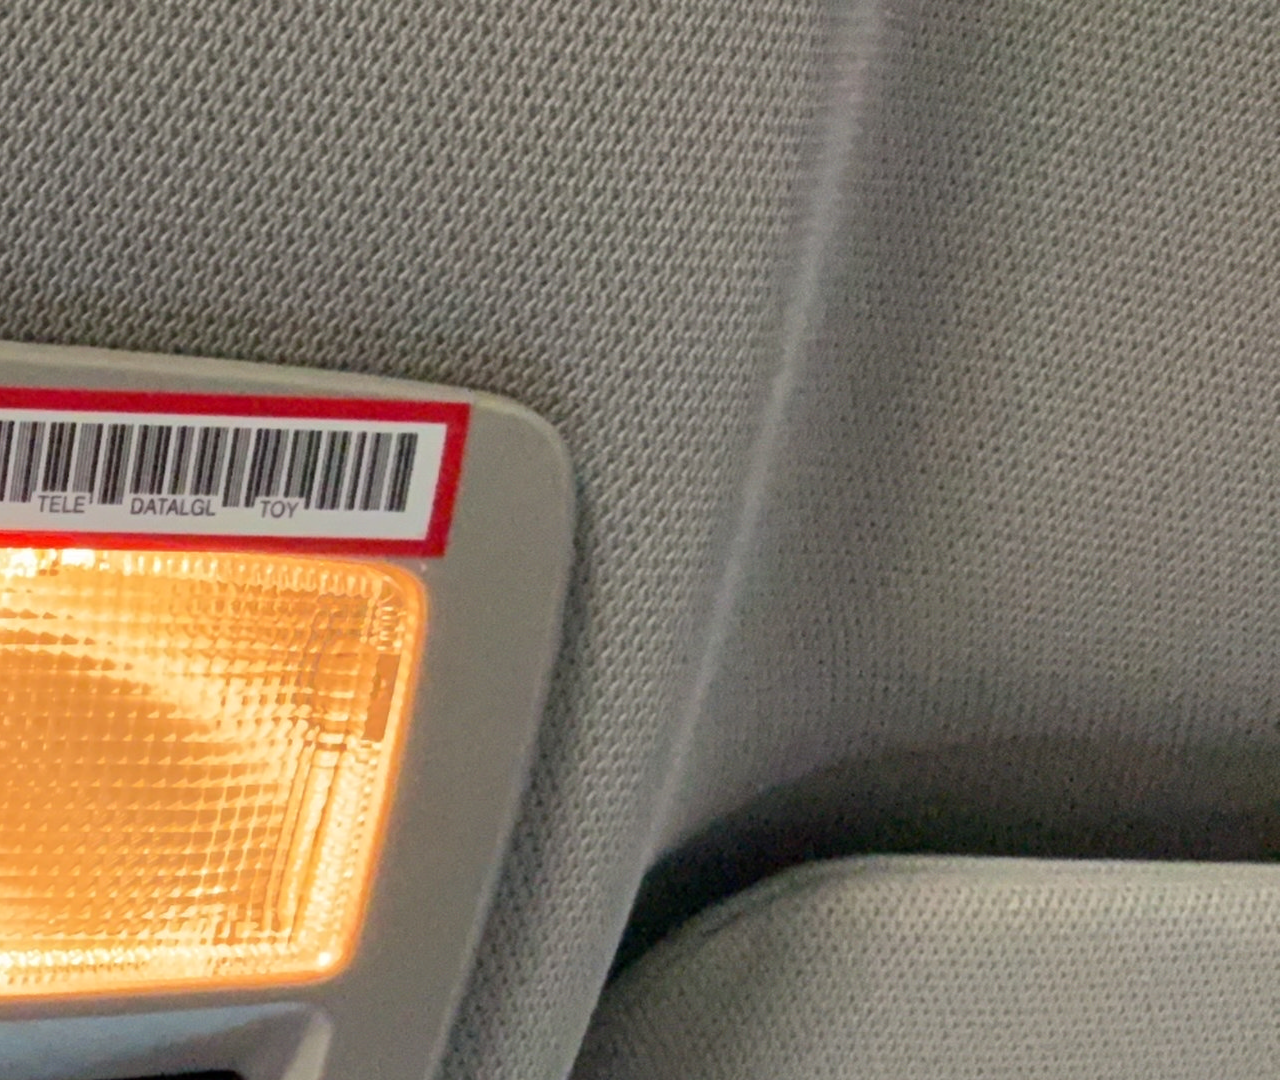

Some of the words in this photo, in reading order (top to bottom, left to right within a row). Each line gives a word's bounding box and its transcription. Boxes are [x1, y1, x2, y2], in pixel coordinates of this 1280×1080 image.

[38, 494, 87, 515] TELE
[130, 498, 216, 518] DATALGL
[258, 500, 300, 519] TOY
